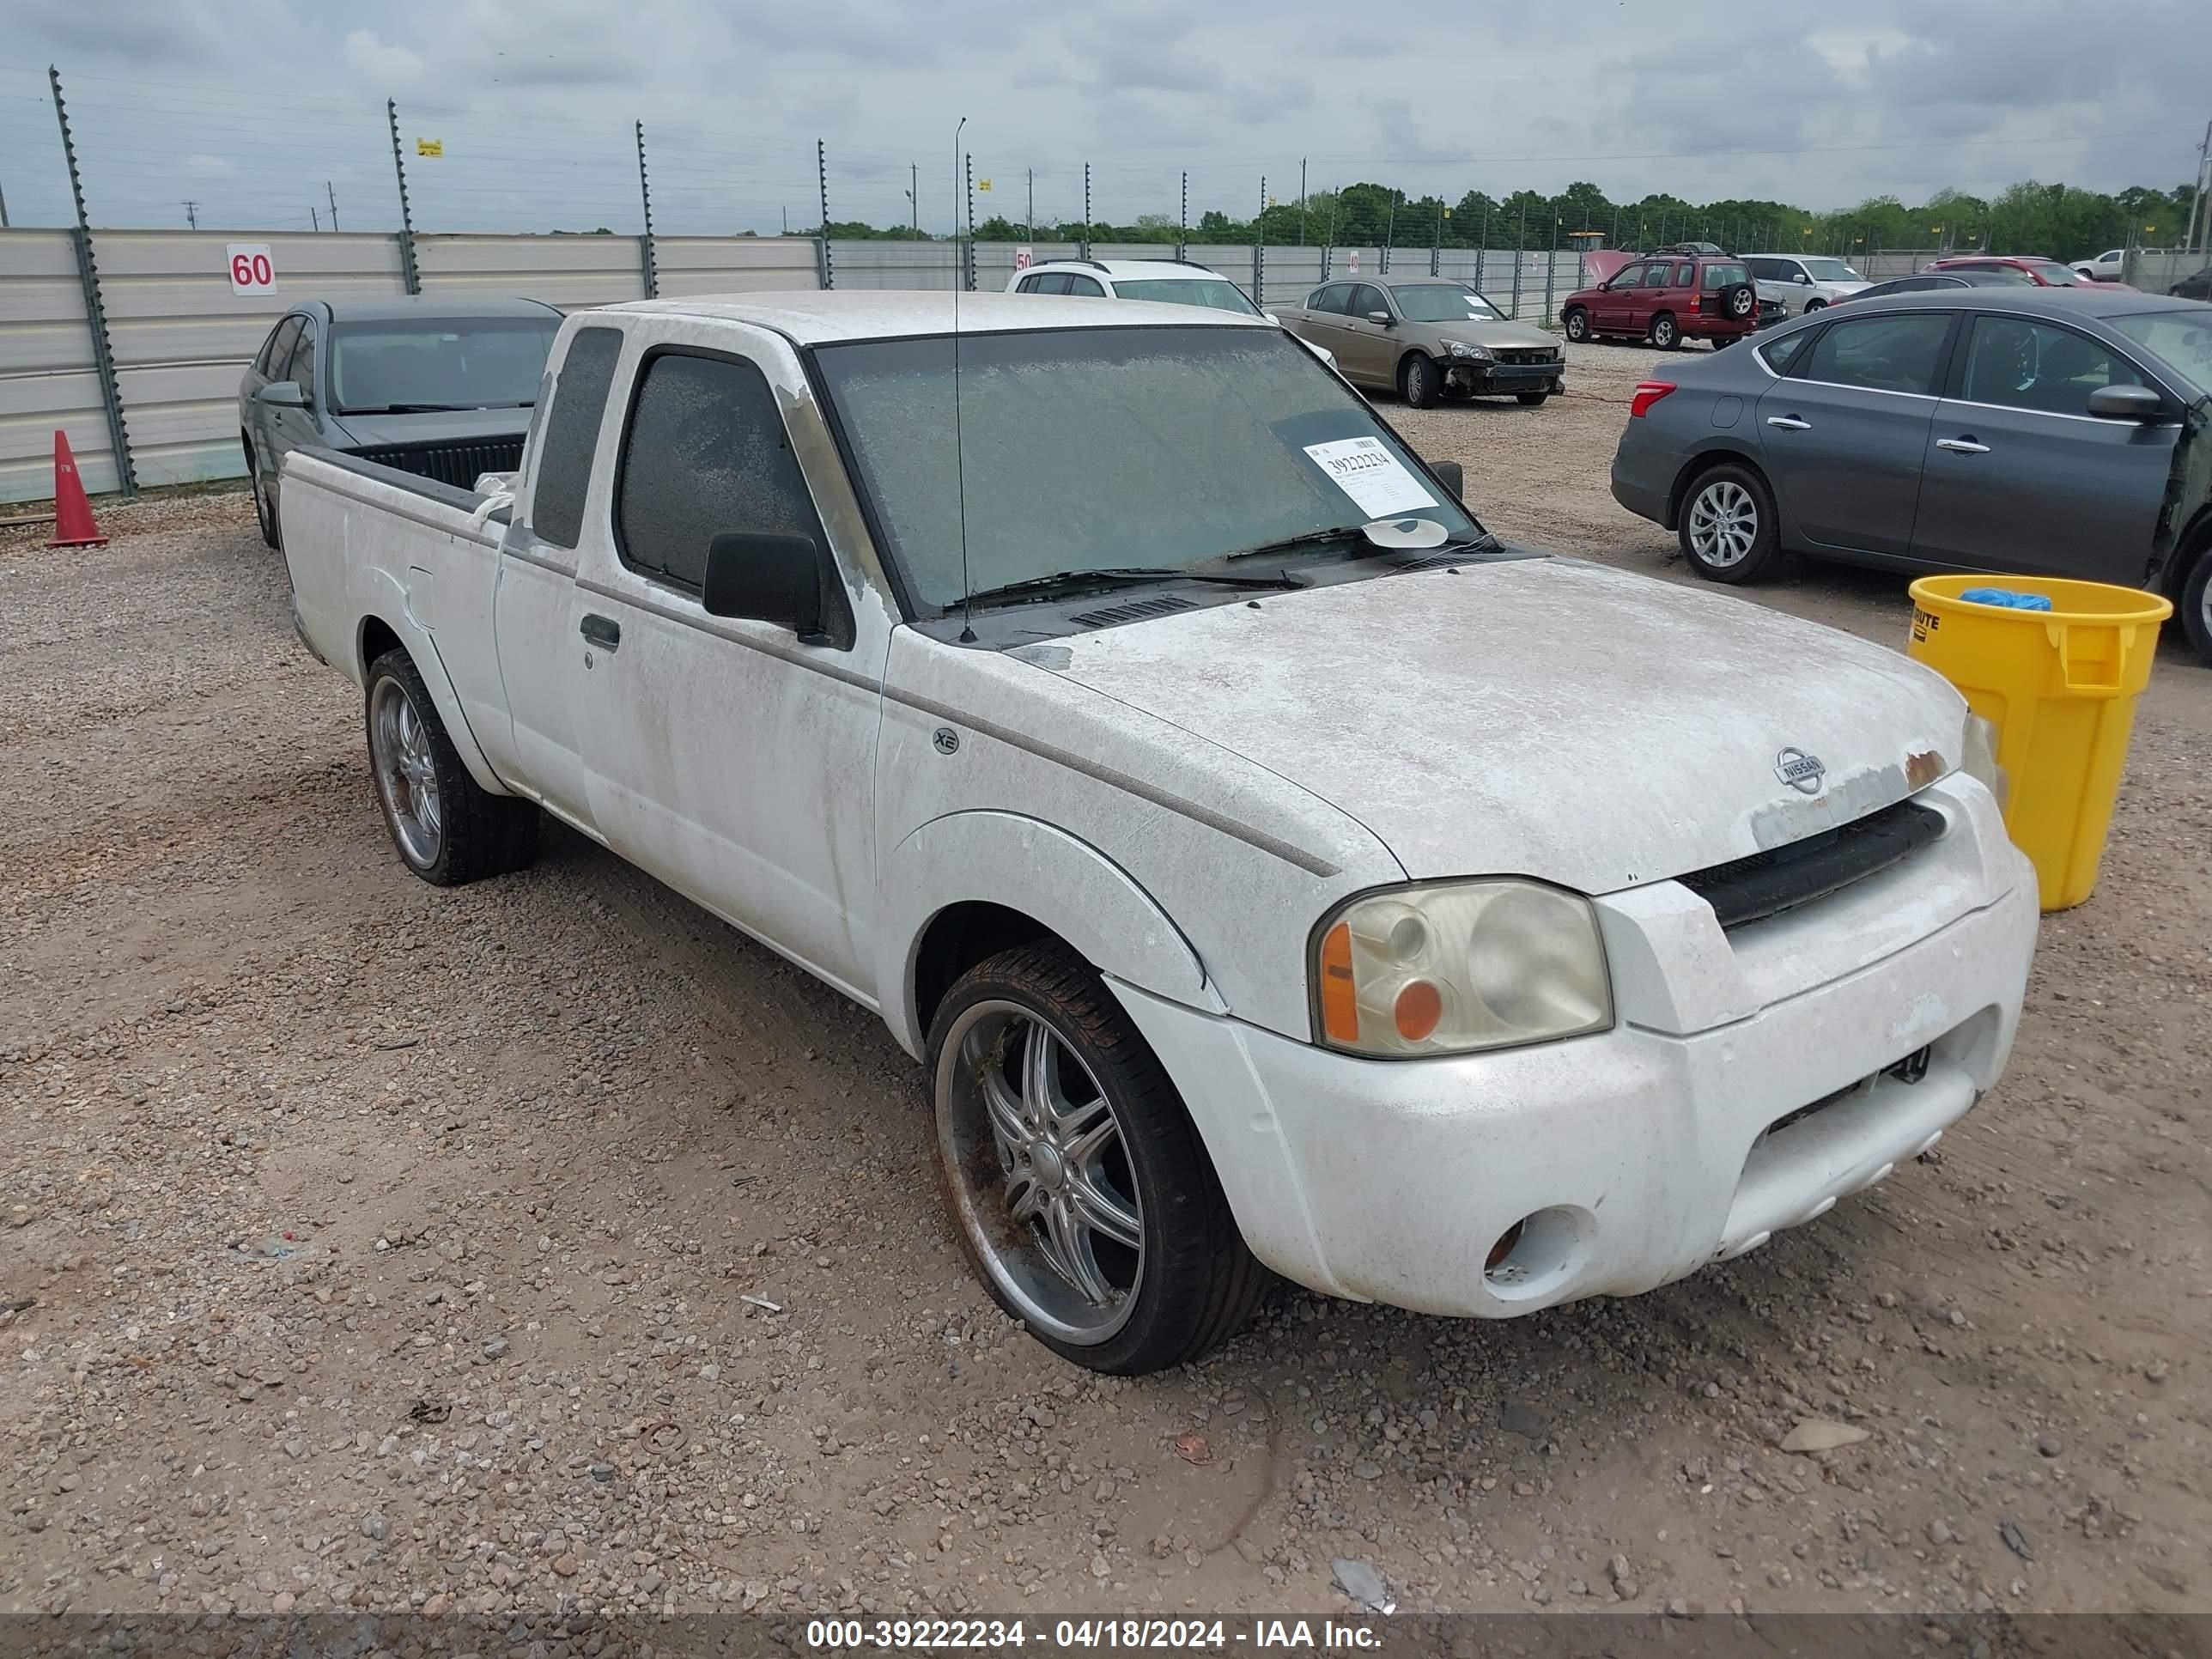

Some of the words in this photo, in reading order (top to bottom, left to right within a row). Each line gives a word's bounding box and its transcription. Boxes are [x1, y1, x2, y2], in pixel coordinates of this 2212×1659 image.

[233, 254, 271, 285] 60
[1018, 253, 1031, 271] 50
[1328, 452, 1392, 474] 39222234
[935, 732, 956, 750] XE
[1784, 760, 1821, 778] NISSAN
